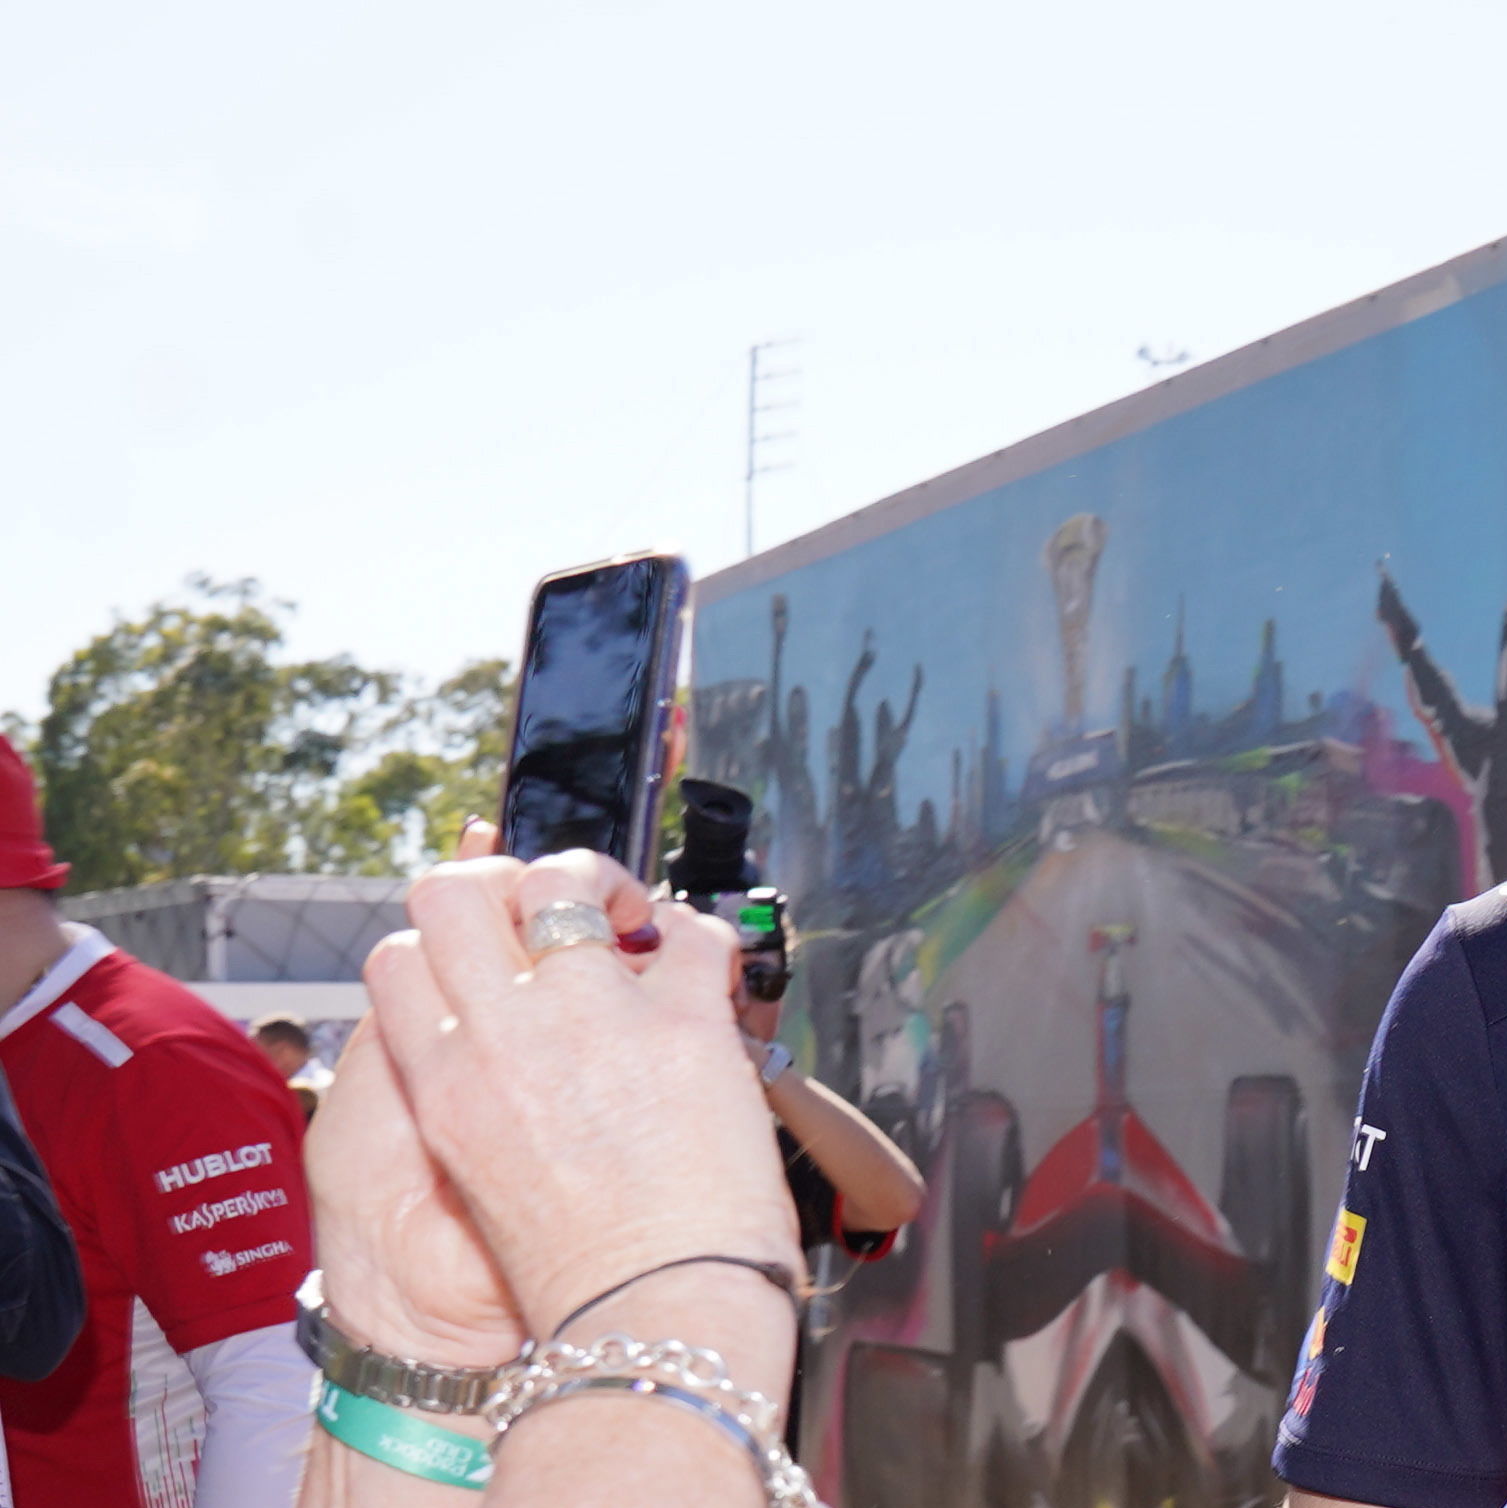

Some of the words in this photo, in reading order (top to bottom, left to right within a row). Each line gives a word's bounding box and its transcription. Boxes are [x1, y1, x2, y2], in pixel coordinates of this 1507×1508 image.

[156, 1142, 273, 1194] HUBLOT
[170, 1189, 279, 1235] KASPERSKY
[234, 1240, 294, 1267] SINGHA
